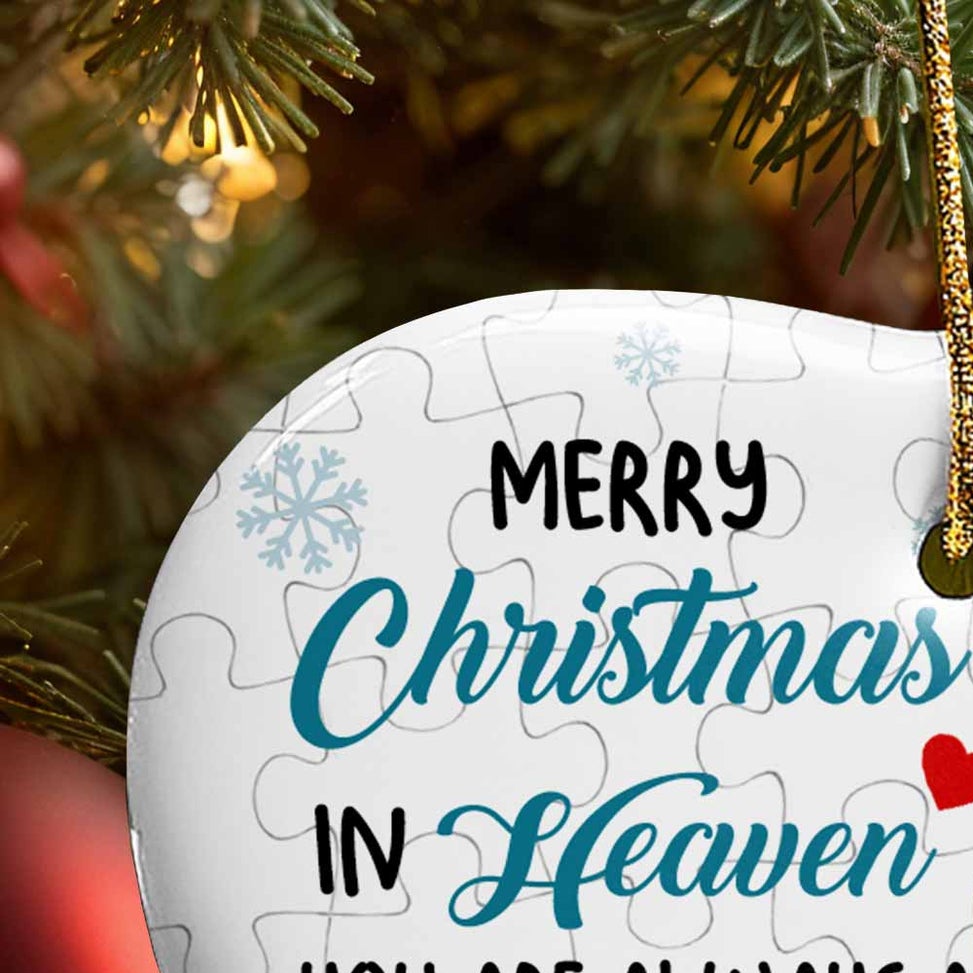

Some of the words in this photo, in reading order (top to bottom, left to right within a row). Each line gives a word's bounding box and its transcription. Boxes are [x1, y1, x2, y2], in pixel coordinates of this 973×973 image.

[491, 439, 767, 538] MERRY
[290, 568, 972, 750] Christmas
[314, 804, 406, 898] IN
[437, 773, 937, 930] Heaven
